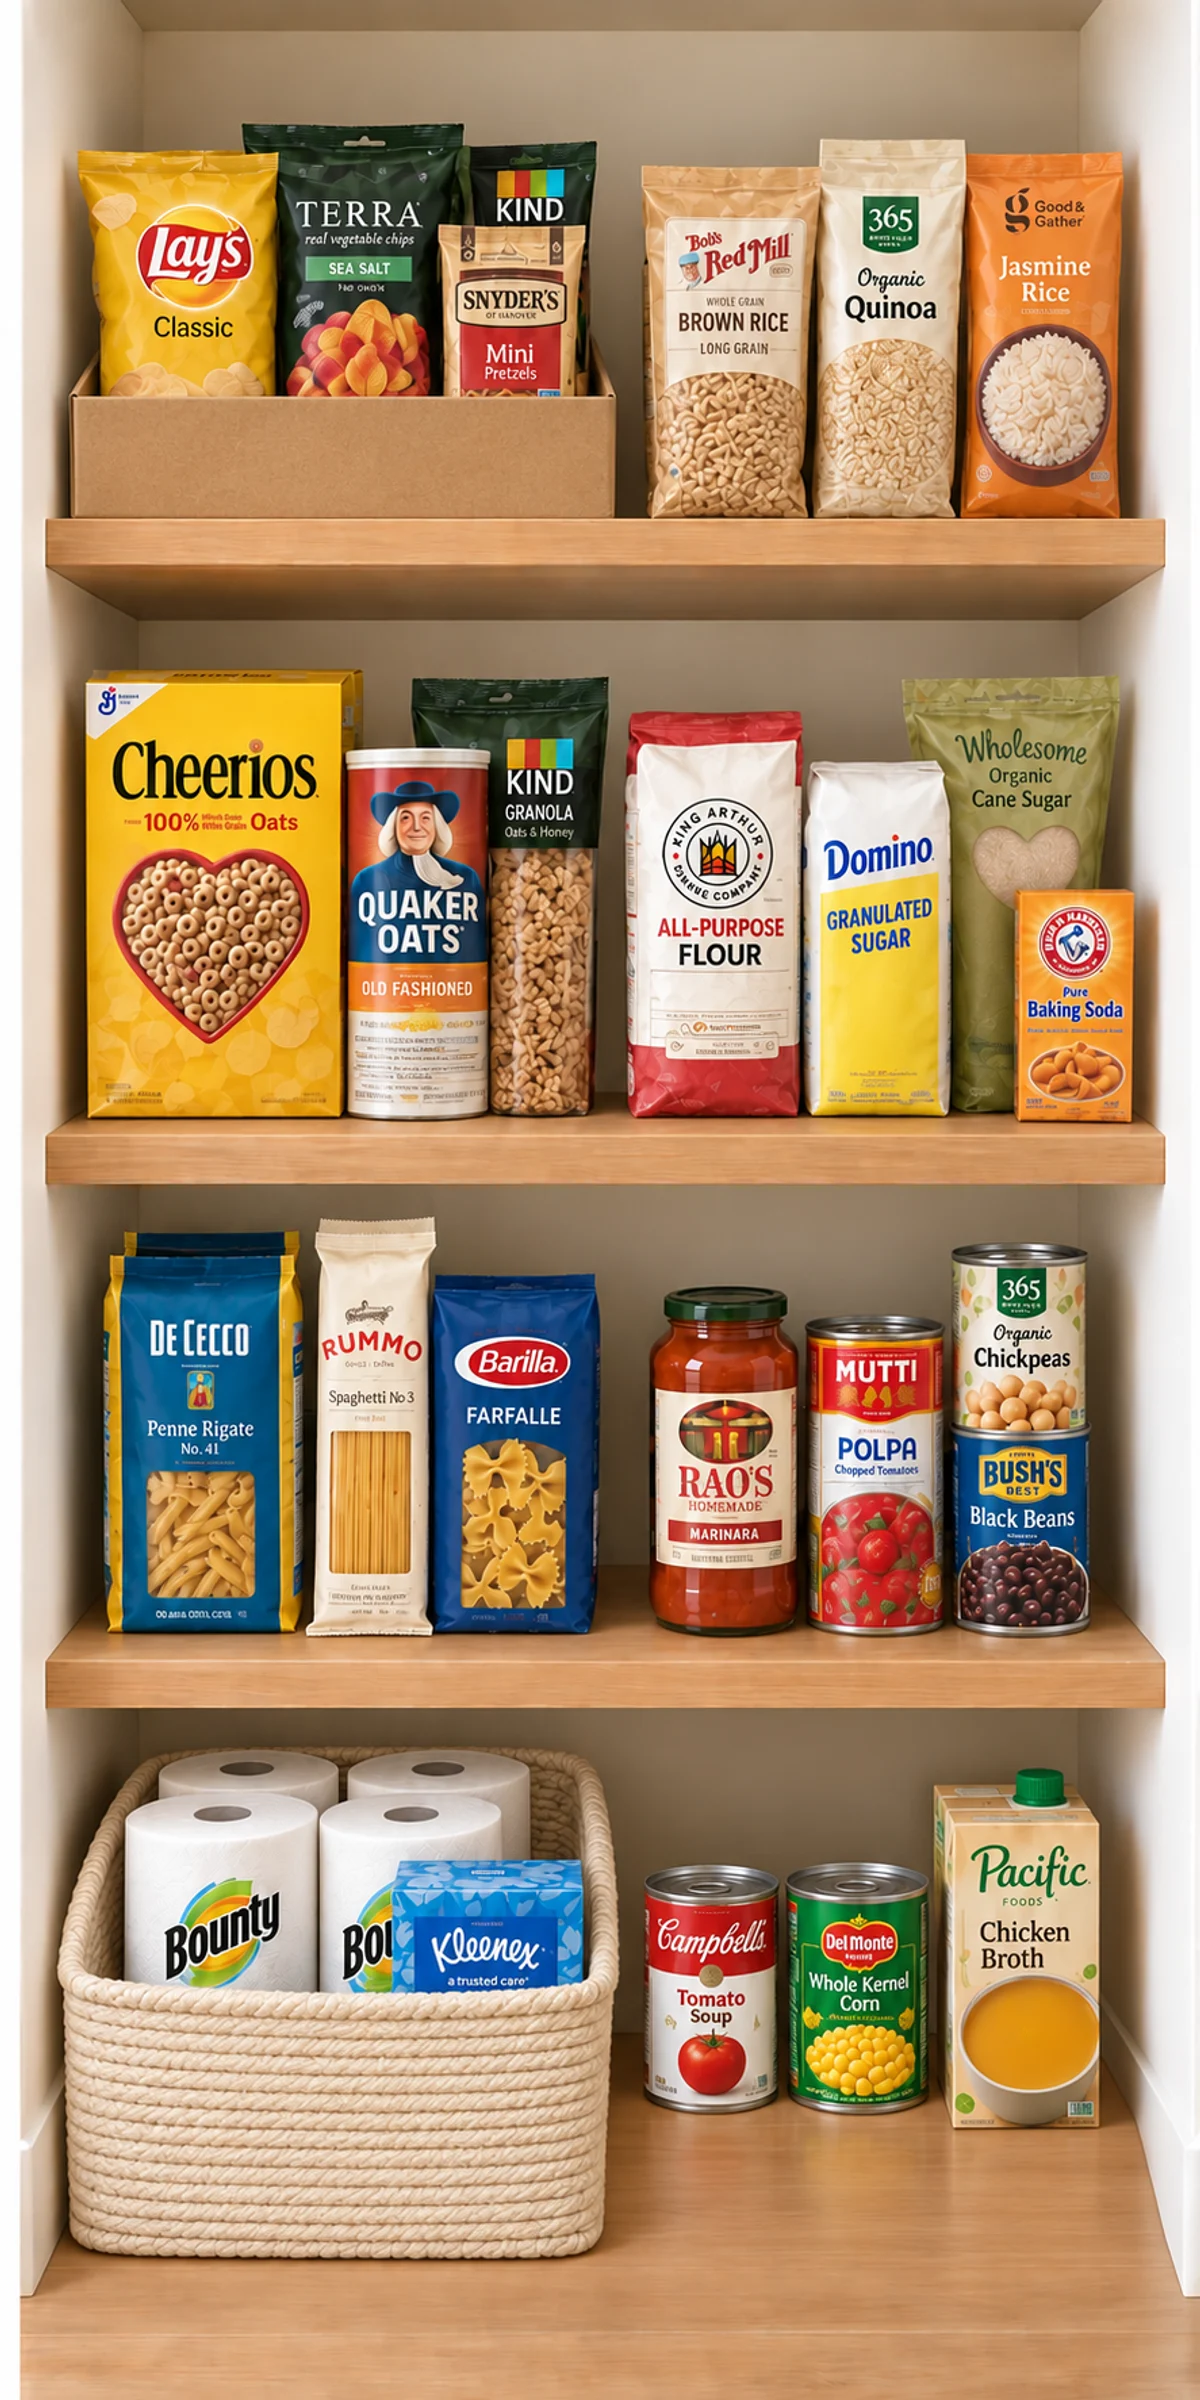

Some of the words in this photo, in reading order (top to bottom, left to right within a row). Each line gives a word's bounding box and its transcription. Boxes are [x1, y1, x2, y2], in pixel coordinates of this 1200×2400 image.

[295, 201, 423, 228] TERRA
[496, 198, 564, 222] KIND
[869, 204, 913, 232] 365
[1034, 200, 1073, 213] Good
[1075, 201, 1085, 213] &
[1035, 215, 1083, 228] Gather
[305, 231, 328, 245] real
[331, 232, 382, 248] vegetable
[385, 232, 415, 248] chips
[685, 231, 723, 252] Bob's
[147, 227, 245, 286] Lay's
[703, 242, 746, 284] Red
[747, 232, 792, 275] Mill
[998, 255, 1091, 281] Jasmine
[328, 262, 354, 275] SEA
[359, 262, 391, 275] SALT
[858, 267, 926, 293] Organic
[463, 289, 559, 313] SNYDER'S
[706, 297, 735, 307] WHOLE
[738, 297, 765, 307] GRAIN
[1021, 281, 1071, 302] Rice
[844, 294, 937, 323] Quinoa
[154, 316, 233, 338] Classic
[679, 312, 744, 332] BROWN
[750, 312, 789, 332] RICE
[485, 344, 534, 364] Mini
[700, 342, 730, 355] LONG
[733, 342, 769, 355] GRAIN
[484, 366, 537, 380] Pretzels
[955, 728, 1088, 765] Wholesome
[112, 739, 317, 800] Cheerios
[989, 767, 1053, 788] Organic
[507, 769, 574, 796] KIND
[505, 804, 574, 820] GRANOLA
[972, 789, 1016, 808] Cane
[1021, 789, 1072, 812] Sugar
[143, 812, 199, 832] 100%
[250, 812, 299, 831] Oats
[505, 826, 527, 838] Oats
[529, 826, 537, 838] &
[540, 825, 574, 840] Honey
[672, 811, 702, 848] KING
[707, 806, 764, 846] ARTHUR
[824, 834, 933, 881] Domino
[358, 889, 479, 927] QUAKER
[826, 897, 933, 931] GRANULATED
[377, 923, 460, 954] OATS
[657, 918, 784, 937] ALL-PURPOSE
[851, 927, 911, 955] SUGAR
[679, 943, 762, 966] FLOUR
[362, 981, 387, 996] OLD
[392, 981, 473, 996] FASHIONED
[1063, 986, 1089, 998] Pure
[1027, 1000, 1081, 1023] Baking
[1084, 1000, 1124, 1018] Soda
[1002, 1275, 1041, 1301] 365
[183, 1319, 249, 1357] CECCO
[321, 1330, 423, 1362] RUMMO
[993, 1323, 1053, 1348] Organic
[836, 1359, 917, 1383] MUTTI
[974, 1347, 1071, 1375] Chickpeas
[328, 1390, 386, 1407] Spaghetti
[466, 1406, 562, 1425] FARFALLE
[147, 1420, 198, 1437] Penne
[202, 1420, 254, 1441] Rigate
[181, 1443, 203, 1455] No.
[205, 1443, 219, 1455] 41
[838, 1436, 917, 1462] POLPA
[678, 1464, 773, 1499] RAO'S
[834, 1464, 875, 1478] Chopped
[877, 1465, 919, 1476] Tomatoes
[984, 1459, 1063, 1488] BUSH'S
[688, 1501, 763, 1513] HOMEMADE
[970, 1505, 1019, 1529] Black
[1023, 1508, 1076, 1529] Beans
[689, 1527, 759, 1541] MARINARA
[970, 1844, 1088, 1899] Pacific
[1002, 1897, 1044, 1907] FOODS
[164, 1891, 280, 1981] Bounty
[825, 1933, 848, 1951] Del
[849, 1935, 894, 1951] Monte
[979, 1919, 1070, 1943] Chicken
[431, 1926, 540, 1974] Kleenex
[980, 1946, 1045, 1970] Broth
[447, 1977, 455, 1986] a
[456, 1976, 498, 1987] trusted
[808, 1971, 858, 1993] Whole
[862, 1970, 909, 1993] Kernel
[677, 1988, 746, 2007] Tomato
[839, 1995, 880, 2012] Corn
[690, 2008, 733, 2029] Soup
